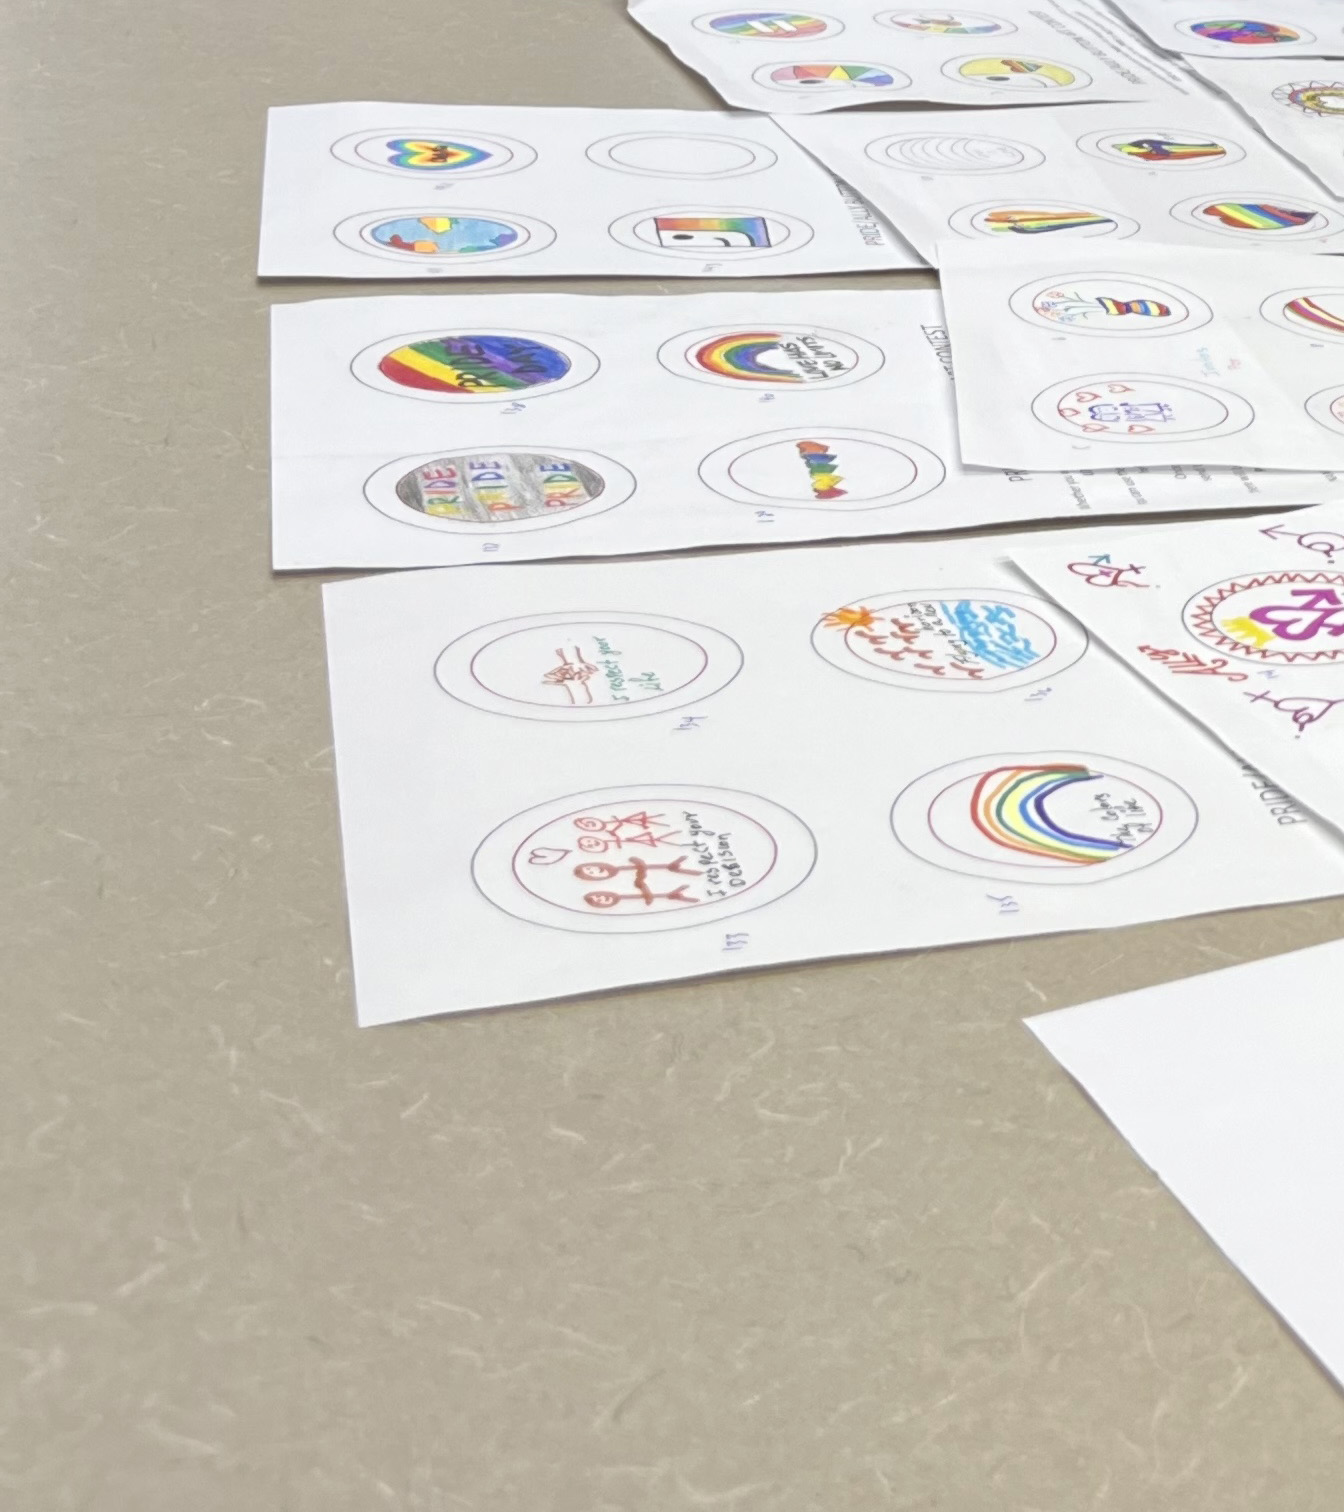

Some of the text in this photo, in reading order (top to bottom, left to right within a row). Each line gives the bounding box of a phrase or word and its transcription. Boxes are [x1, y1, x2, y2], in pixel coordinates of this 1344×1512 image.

[447, 342, 507, 388] PRIDE
[506, 345, 549, 374] DAY
[422, 464, 461, 516] PRIDE
[540, 463, 585, 508] PRIDE
[592, 636, 622, 655] your
[596, 660, 627, 691] respect
[682, 810, 716, 837] your
[690, 841, 722, 885] respect
